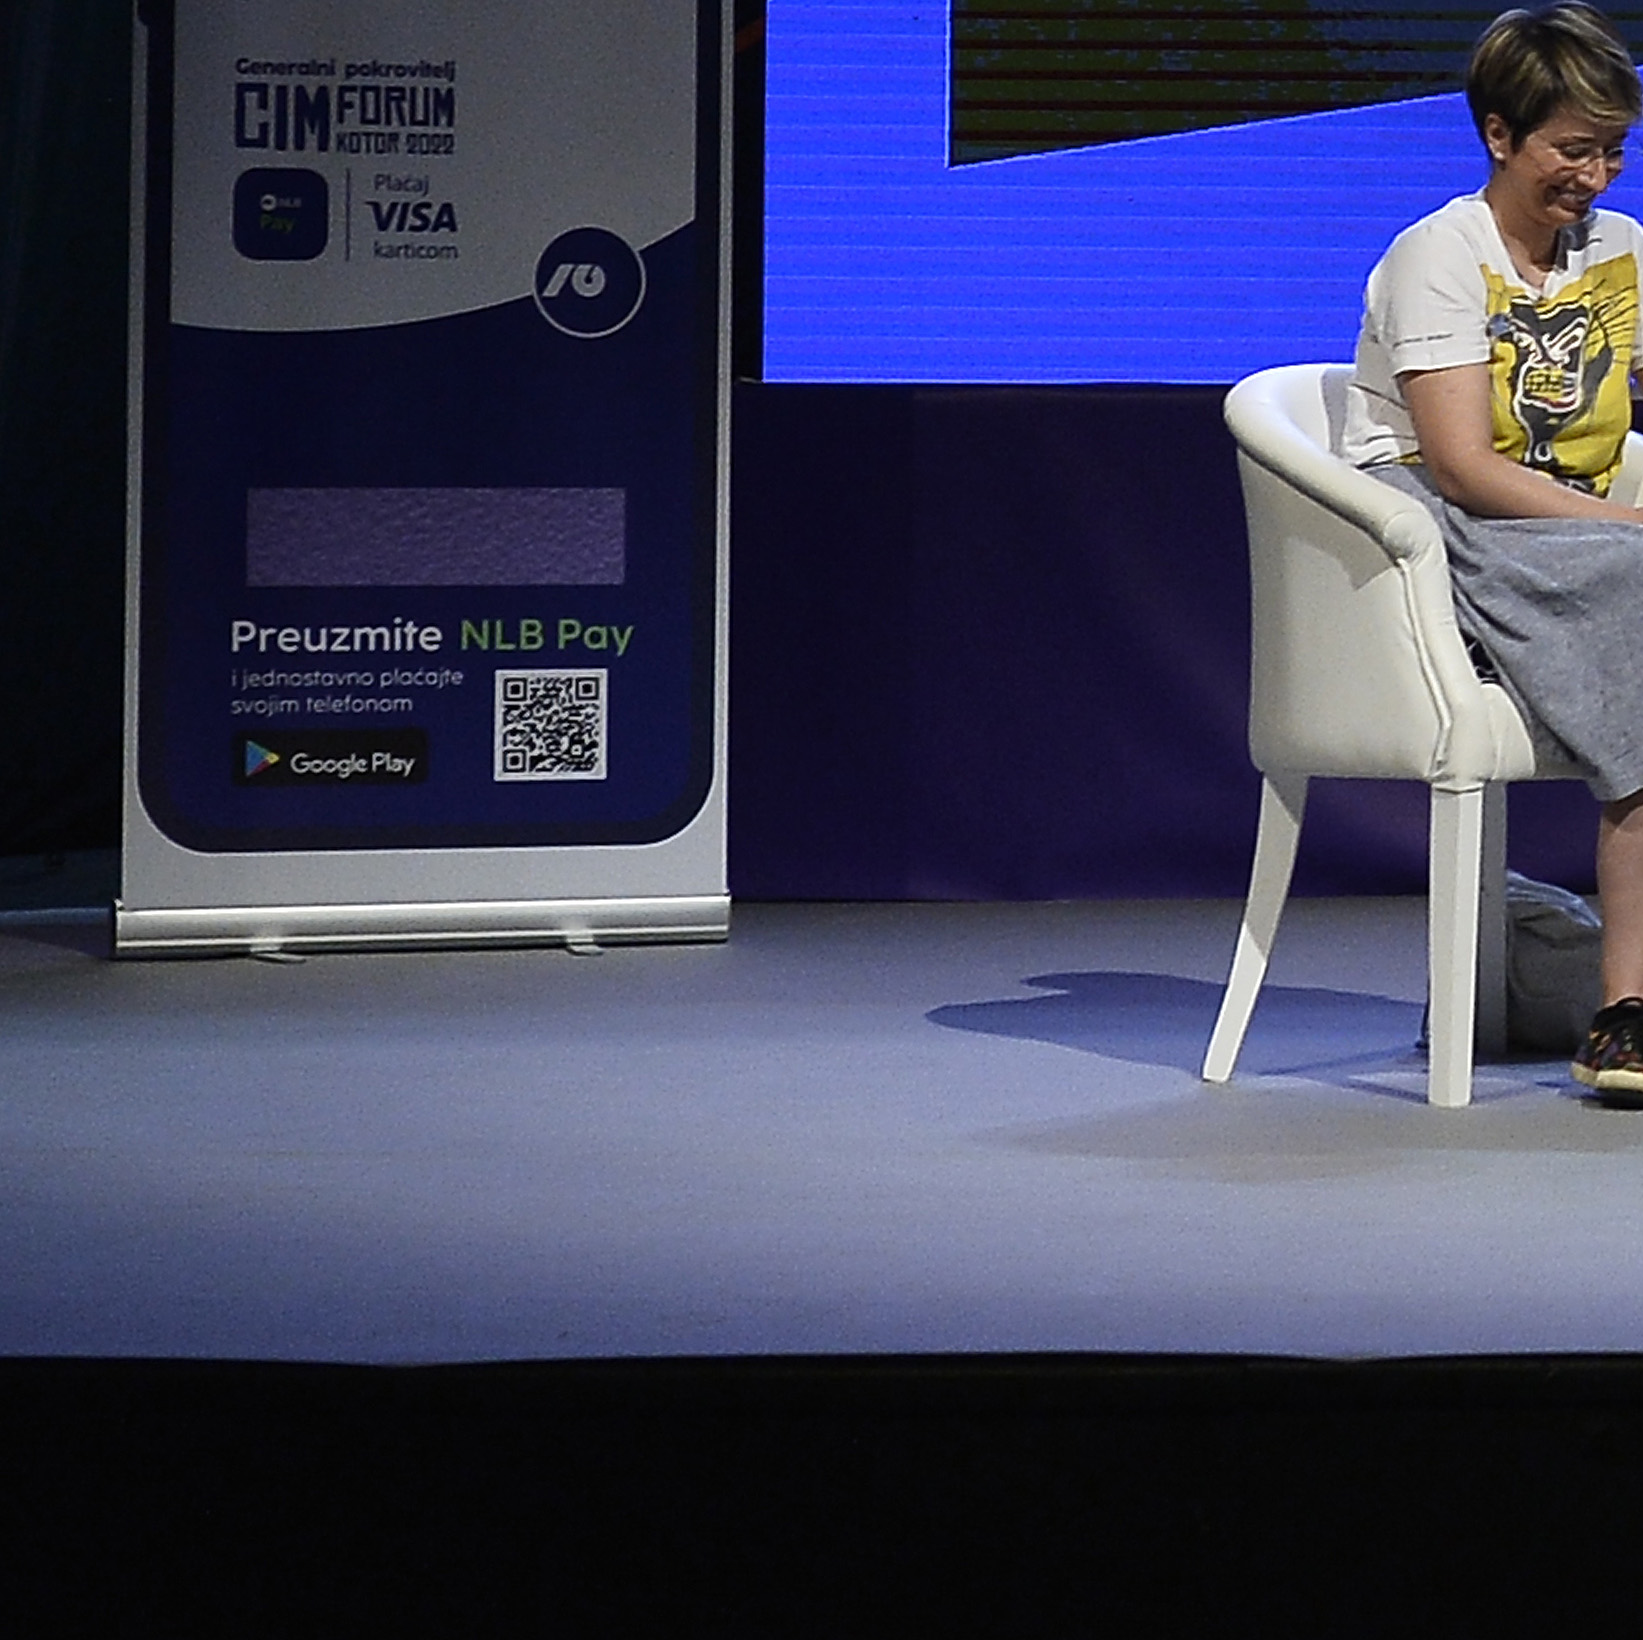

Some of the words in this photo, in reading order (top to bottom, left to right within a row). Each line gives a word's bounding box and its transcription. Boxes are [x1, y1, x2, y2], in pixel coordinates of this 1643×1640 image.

[235, 59, 336, 76] Generalni
[344, 61, 456, 83] pokrovitelj
[235, 82, 331, 152] CIM
[336, 84, 455, 127] FORUM
[336, 131, 400, 154] KOTOR
[406, 133, 455, 155] 2022
[365, 201, 459, 233] VISA
[373, 241, 459, 259] karticom
[230, 617, 443, 653] Preuzmite
[460, 618, 545, 652] NLB
[557, 618, 634, 656] Pay
[231, 698, 299, 718] svojim
[290, 753, 367, 778] Google
[371, 752, 416, 776] Play
